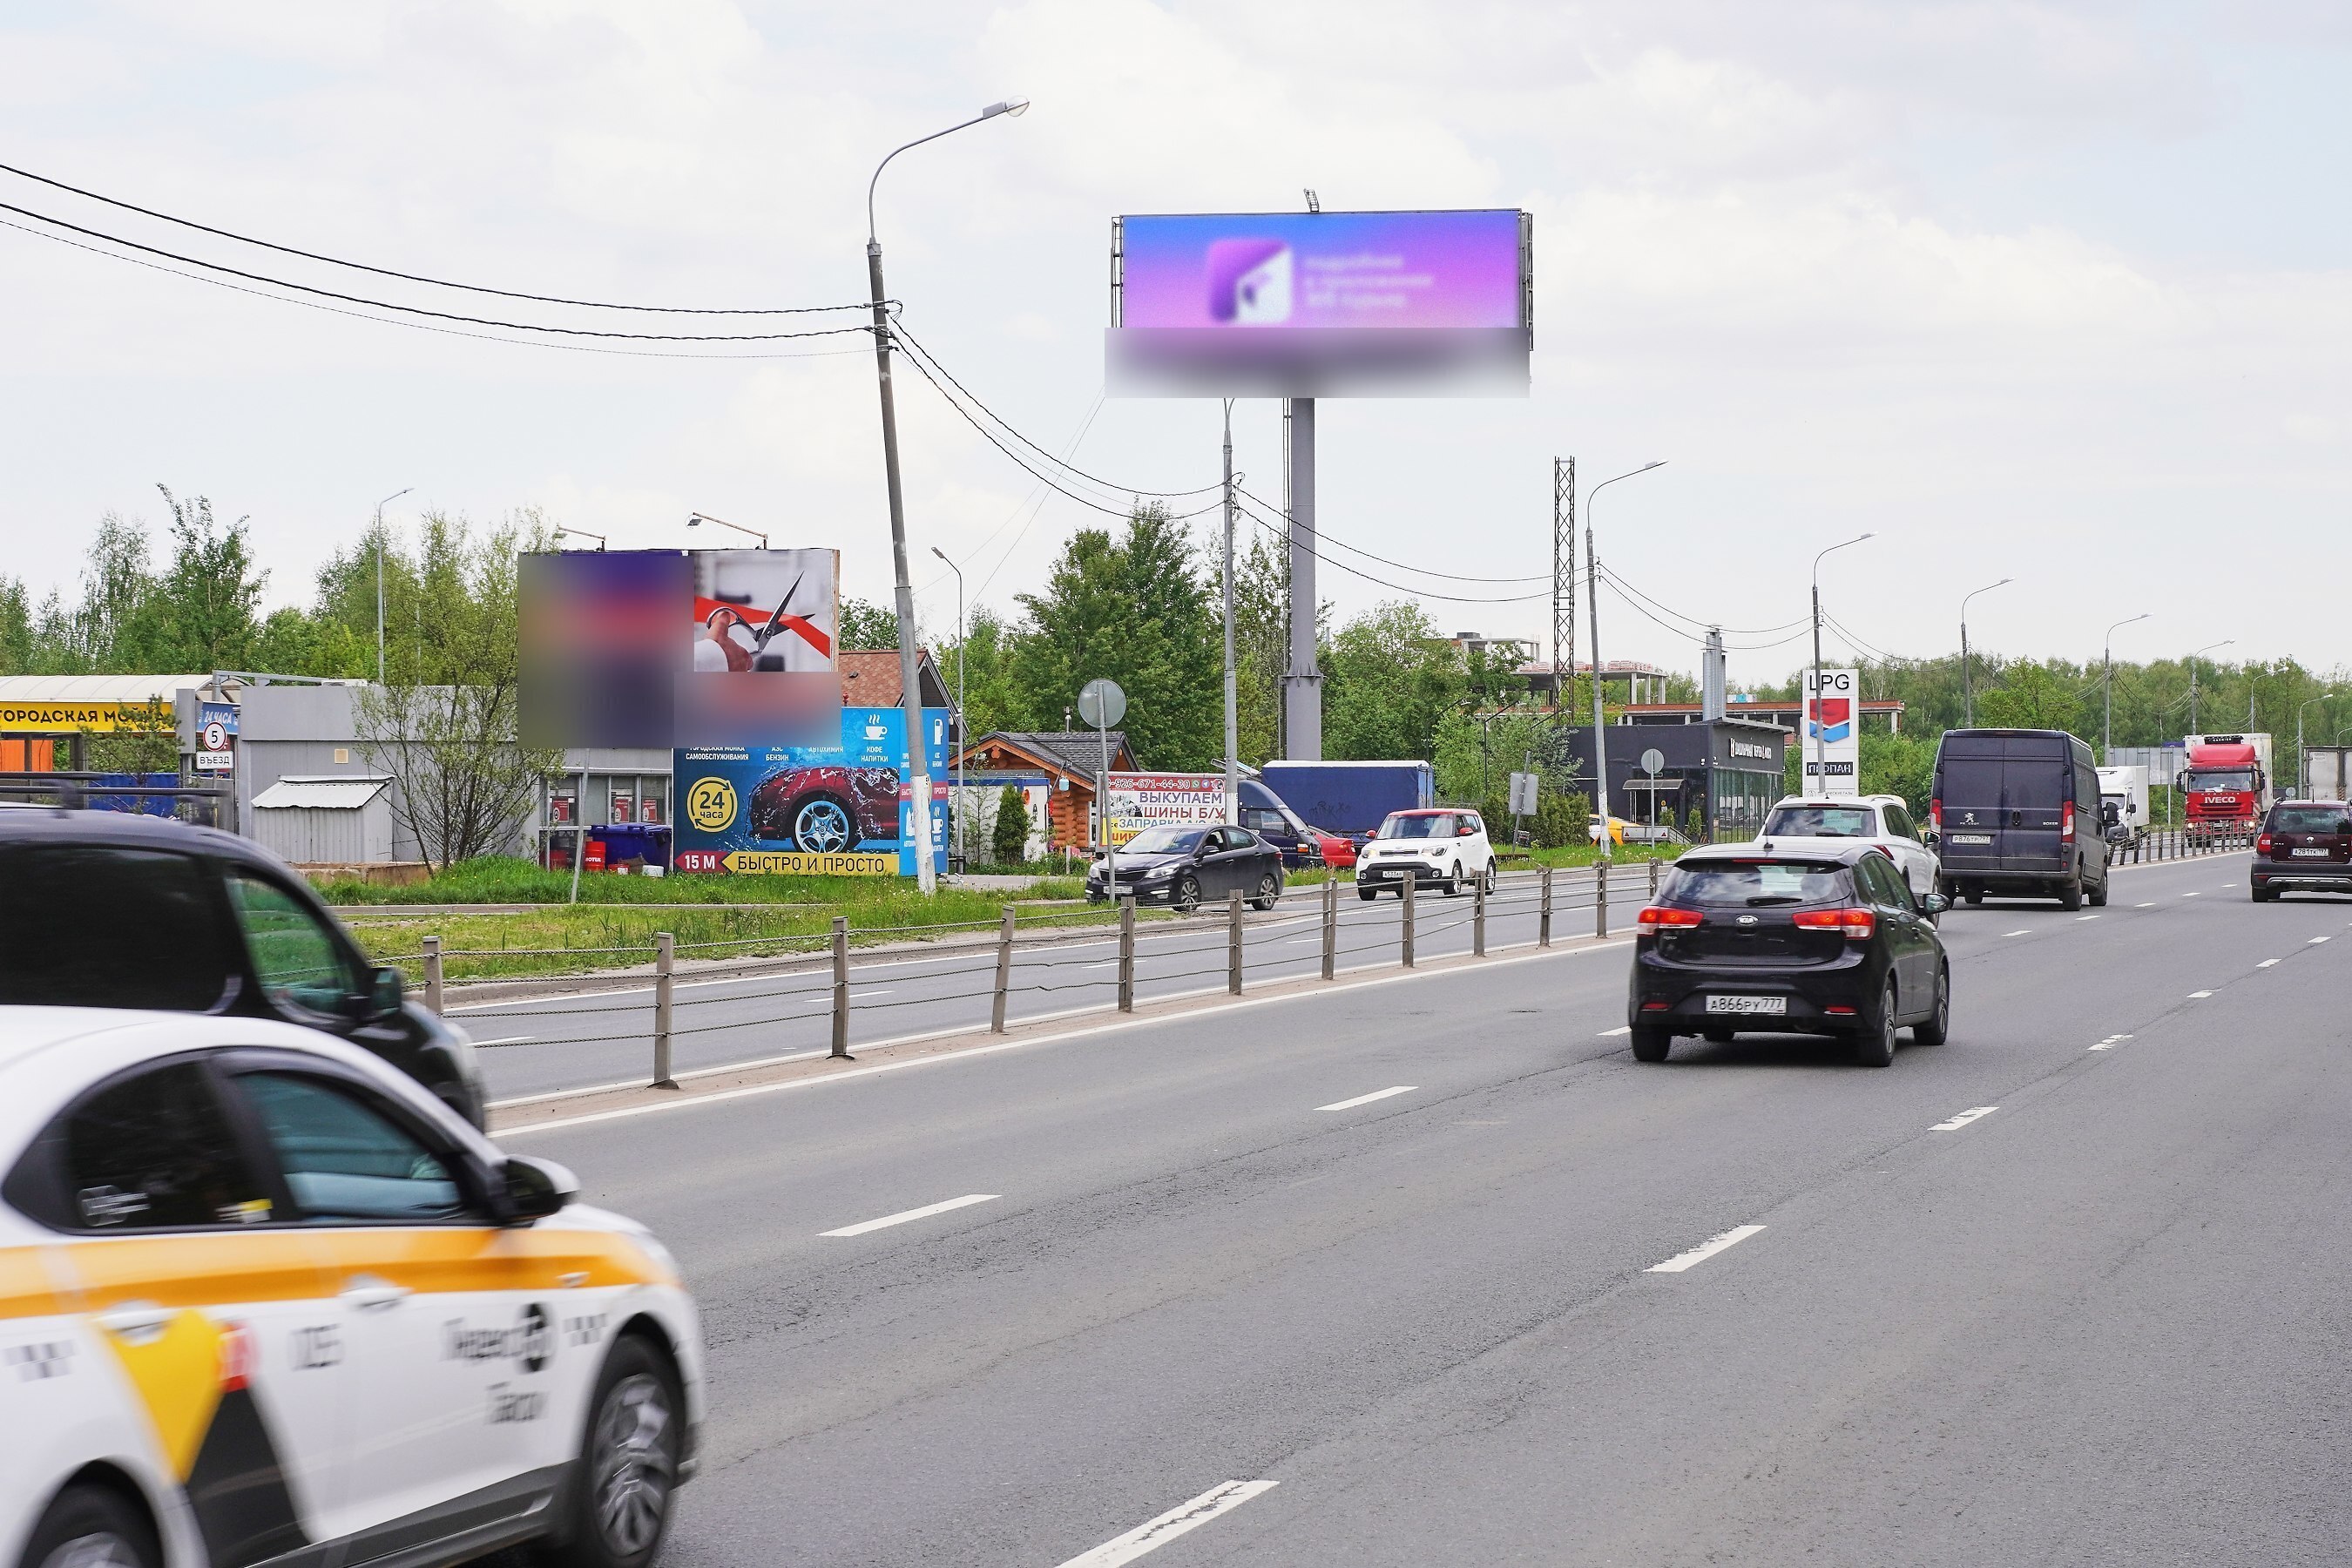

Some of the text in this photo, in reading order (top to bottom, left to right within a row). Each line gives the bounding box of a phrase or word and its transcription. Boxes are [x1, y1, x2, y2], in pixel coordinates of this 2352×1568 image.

[1808, 673, 1849, 690] LPG
[211, 730, 219, 743] 5
[199, 756, 230, 765] ВЪЕЗД
[700, 791, 725, 809] 24
[1139, 792, 1222, 804] ВЫКУПАЕМ
[1144, 807, 1193, 819] ШИНЫ
[1199, 808, 1225, 819] Б/У
[685, 855, 715, 869] 15 М
[738, 855, 884, 872] БЫСТРО И ПРОСТО
